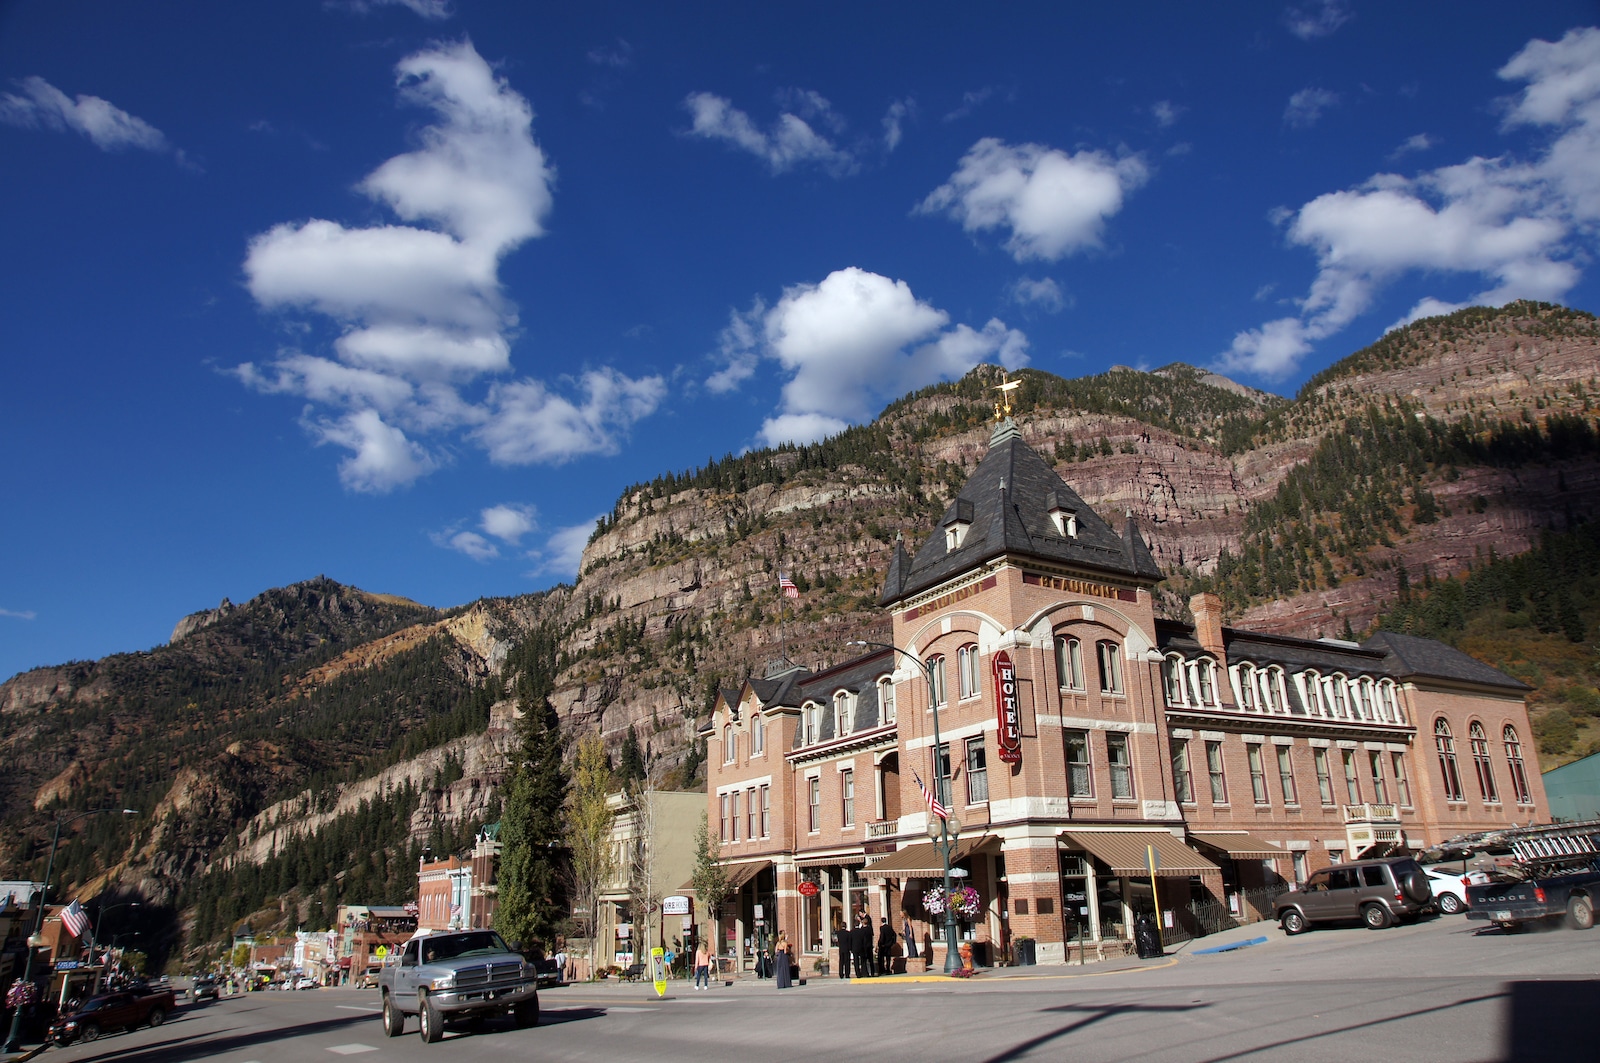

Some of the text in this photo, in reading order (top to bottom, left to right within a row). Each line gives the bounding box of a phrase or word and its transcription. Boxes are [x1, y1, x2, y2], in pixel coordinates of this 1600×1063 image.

[918, 581, 984, 616] BEAUMONT
[1040, 576, 1119, 600] BEAUMONT
[1001, 668, 1016, 739] HOTEL
[1478, 894, 1526, 903] DODGE
